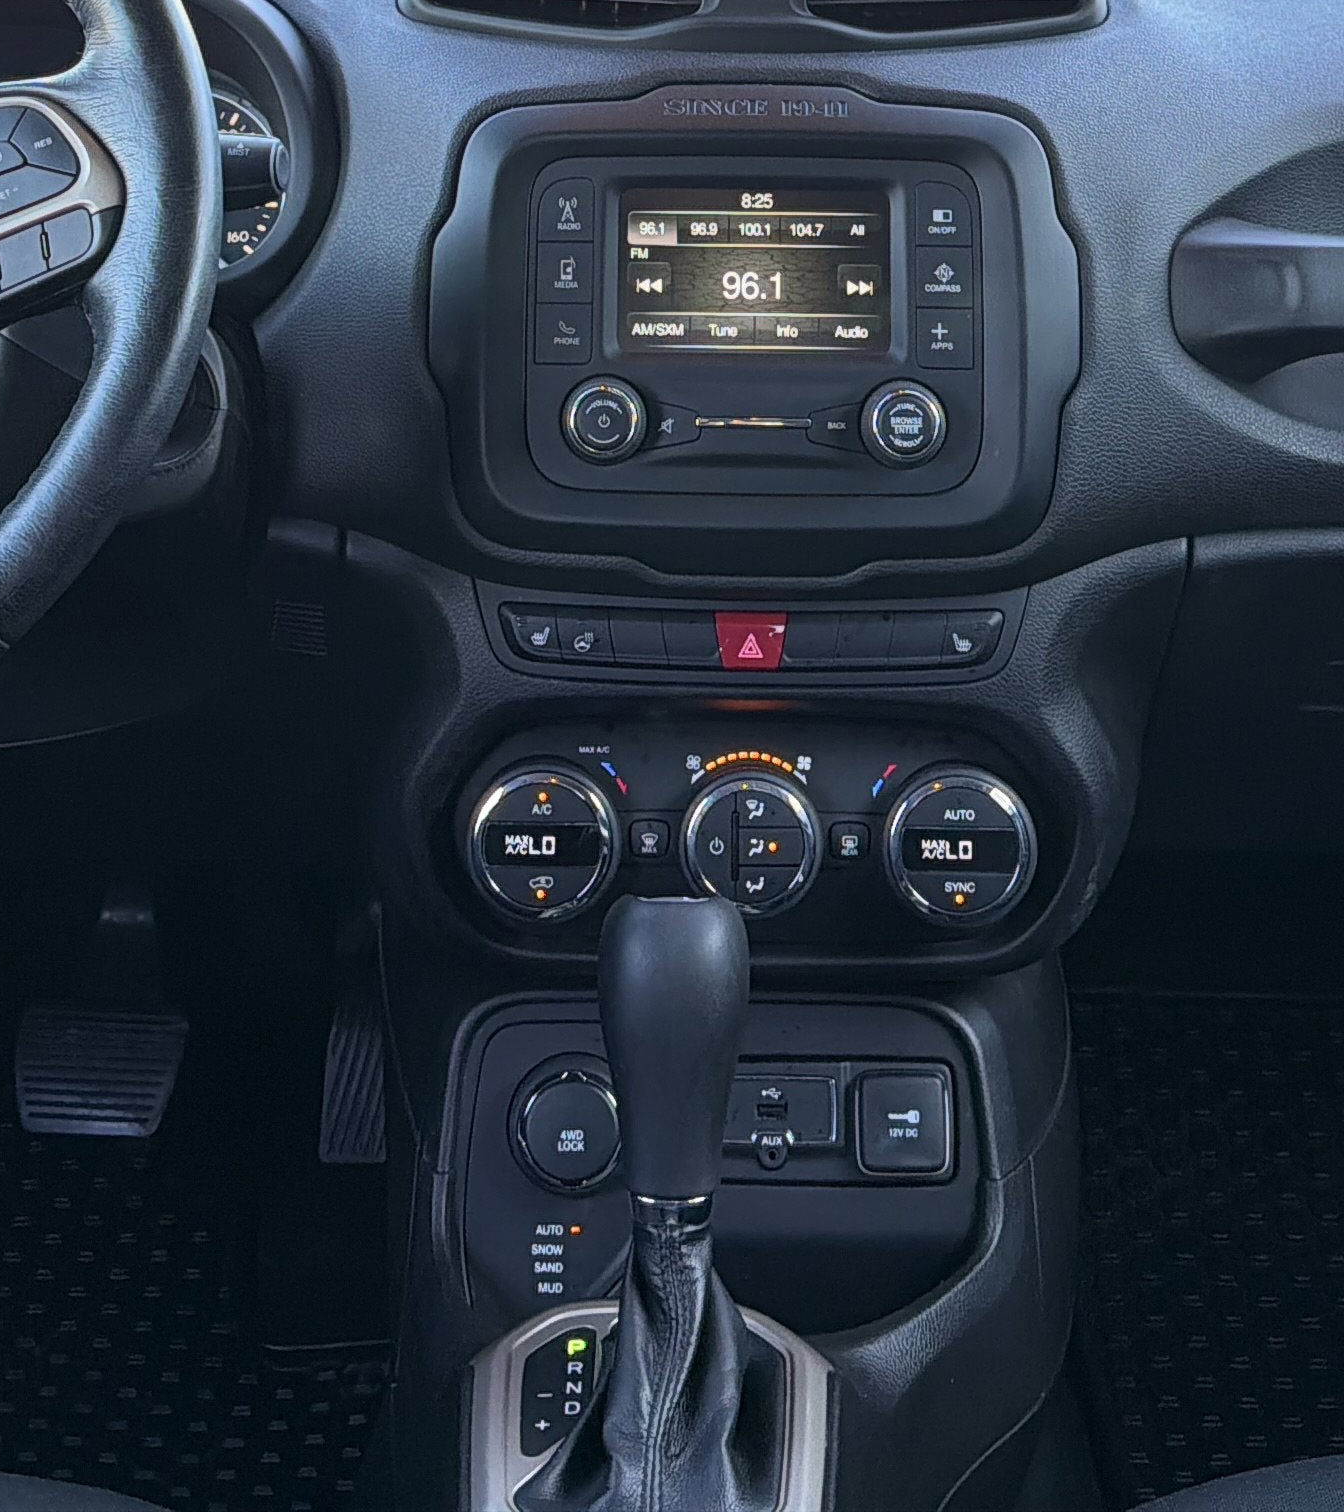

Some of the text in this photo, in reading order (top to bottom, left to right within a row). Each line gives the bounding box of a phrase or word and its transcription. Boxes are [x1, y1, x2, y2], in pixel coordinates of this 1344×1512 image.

[663, 99, 769, 117] SINCE
[740, 193, 774, 210] 8:25
[557, 221, 582, 231] RADIO
[639, 221, 865, 238] 96.1 96.9 100.1 104.7 All
[928, 225, 957, 235] ON/OFF
[227, 231, 249, 244] 160
[630, 248, 649, 260] FM
[554, 280, 579, 290] MEDIA
[722, 271, 783, 300] 96.1
[924, 283, 962, 293] COMPASS
[631, 323, 869, 340] AM/SXM Tune Info Audio
[553, 336, 580, 346] PHONE
[930, 341, 954, 352] APPS
[827, 421, 846, 430] BACK
[890, 416, 922, 425] BROWSE
[894, 426, 919, 434] ENTER
[578, 746, 610, 754] MAX A/C
[532, 804, 552, 815] A/C
[944, 809, 975, 821] AUTO
[505, 834, 529, 845] MAX
[921, 839, 946, 849] MAX
[505, 845, 529, 855] A/C
[921, 849, 945, 860] A/C
[944, 882, 976, 893] SYNC
[559, 1129, 584, 1141] 4WD
[888, 1128, 904, 1138] 12V
[557, 1140, 585, 1152] LOCK
[761, 1136, 783, 1146] AUX
[535, 1225, 564, 1236] AUTO
[531, 1244, 564, 1256] SNOW
[534, 1262, 564, 1273] SAND
[537, 1282, 564, 1294] MUD
[567, 1338, 587, 1356] P
[567, 1362, 583, 1375] R
[565, 1381, 582, 1395] N
[564, 1401, 581, 1415] D
